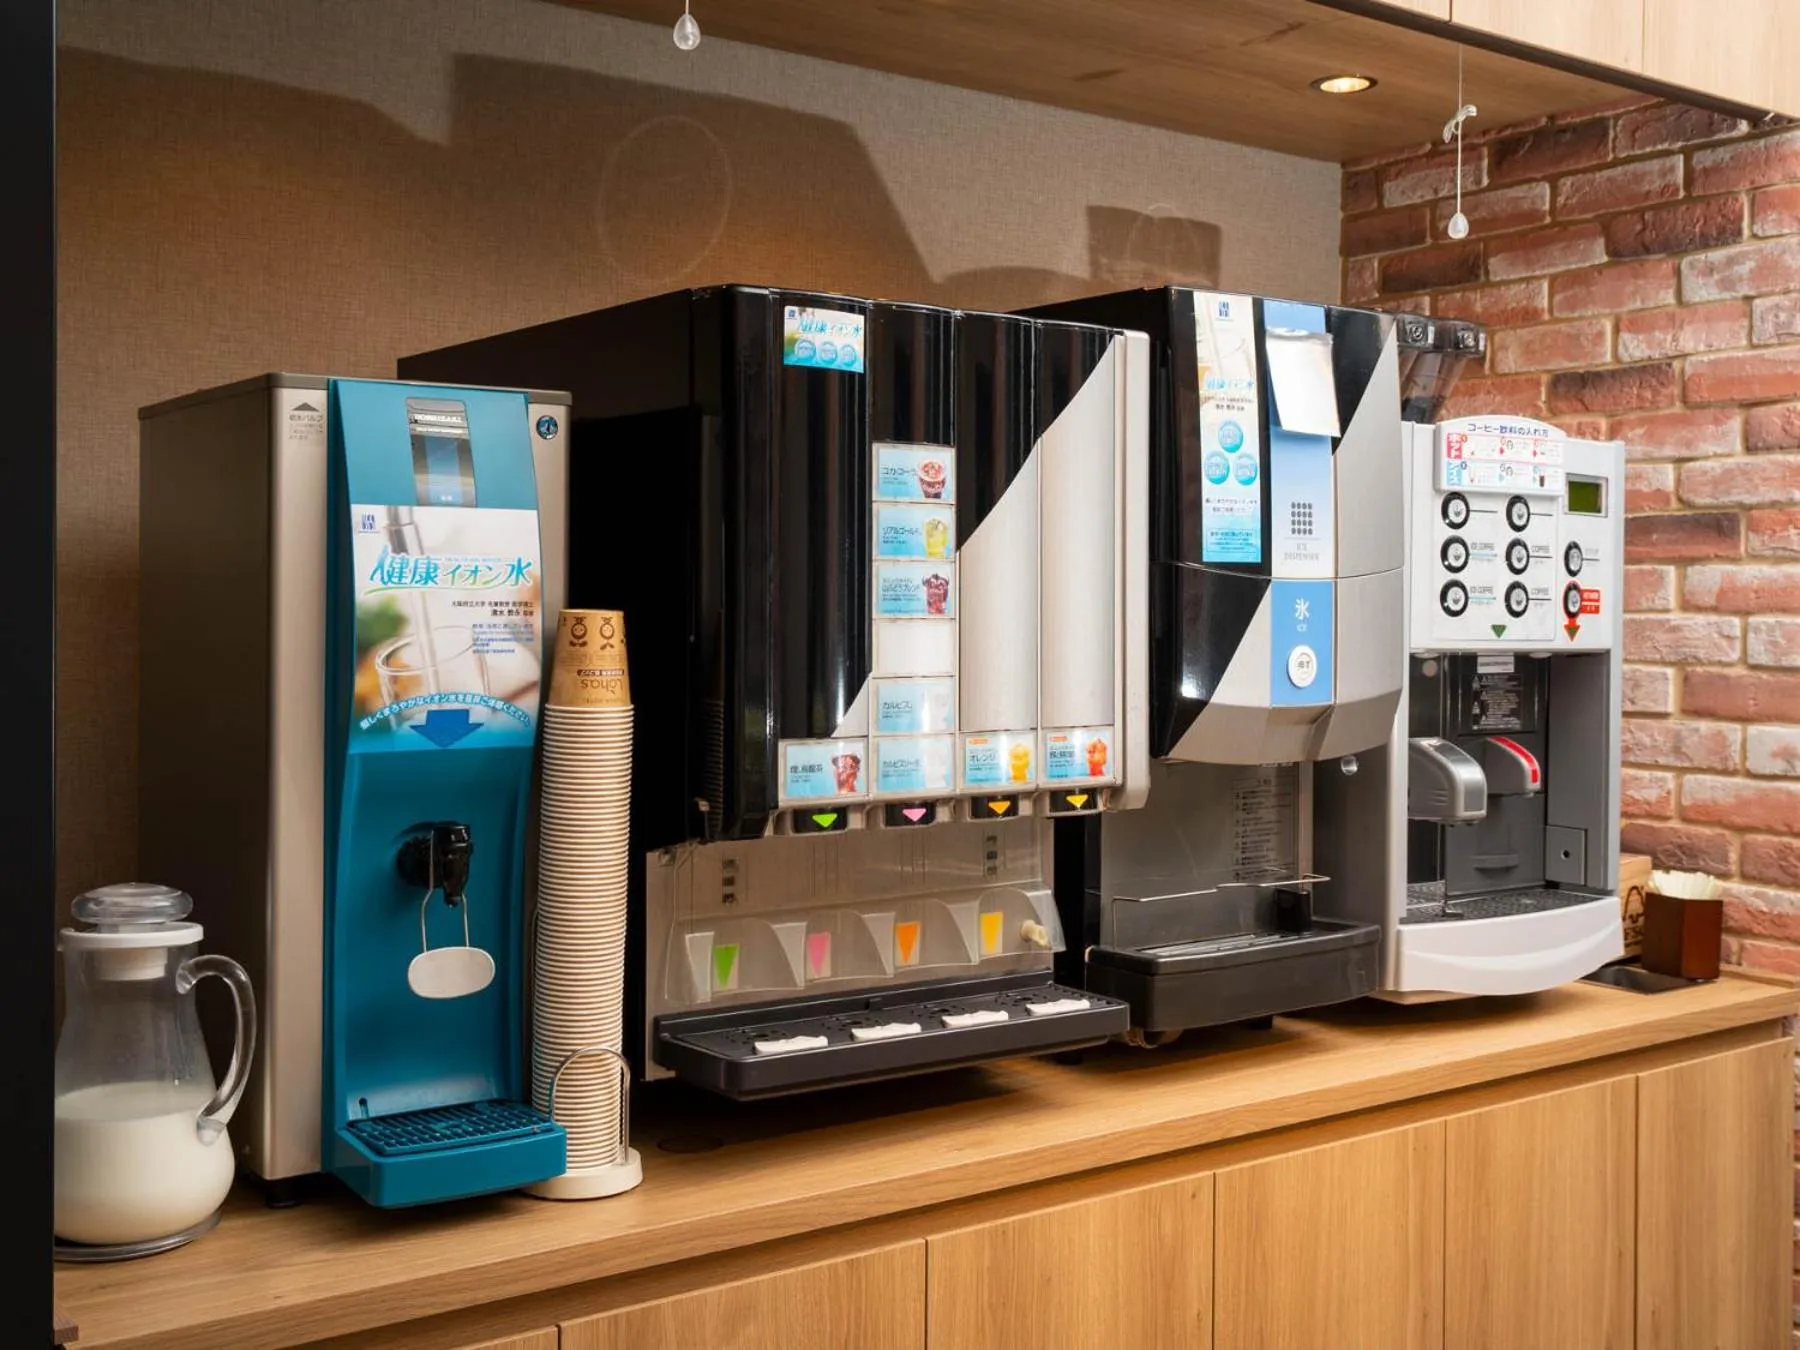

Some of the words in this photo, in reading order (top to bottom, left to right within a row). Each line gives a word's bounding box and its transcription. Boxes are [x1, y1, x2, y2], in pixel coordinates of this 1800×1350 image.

[1468, 423, 1549, 438] コーヒー飲料の入れ方
[370, 546, 532, 587] 健康イオン水
[1295, 598, 1309, 620] 氷
